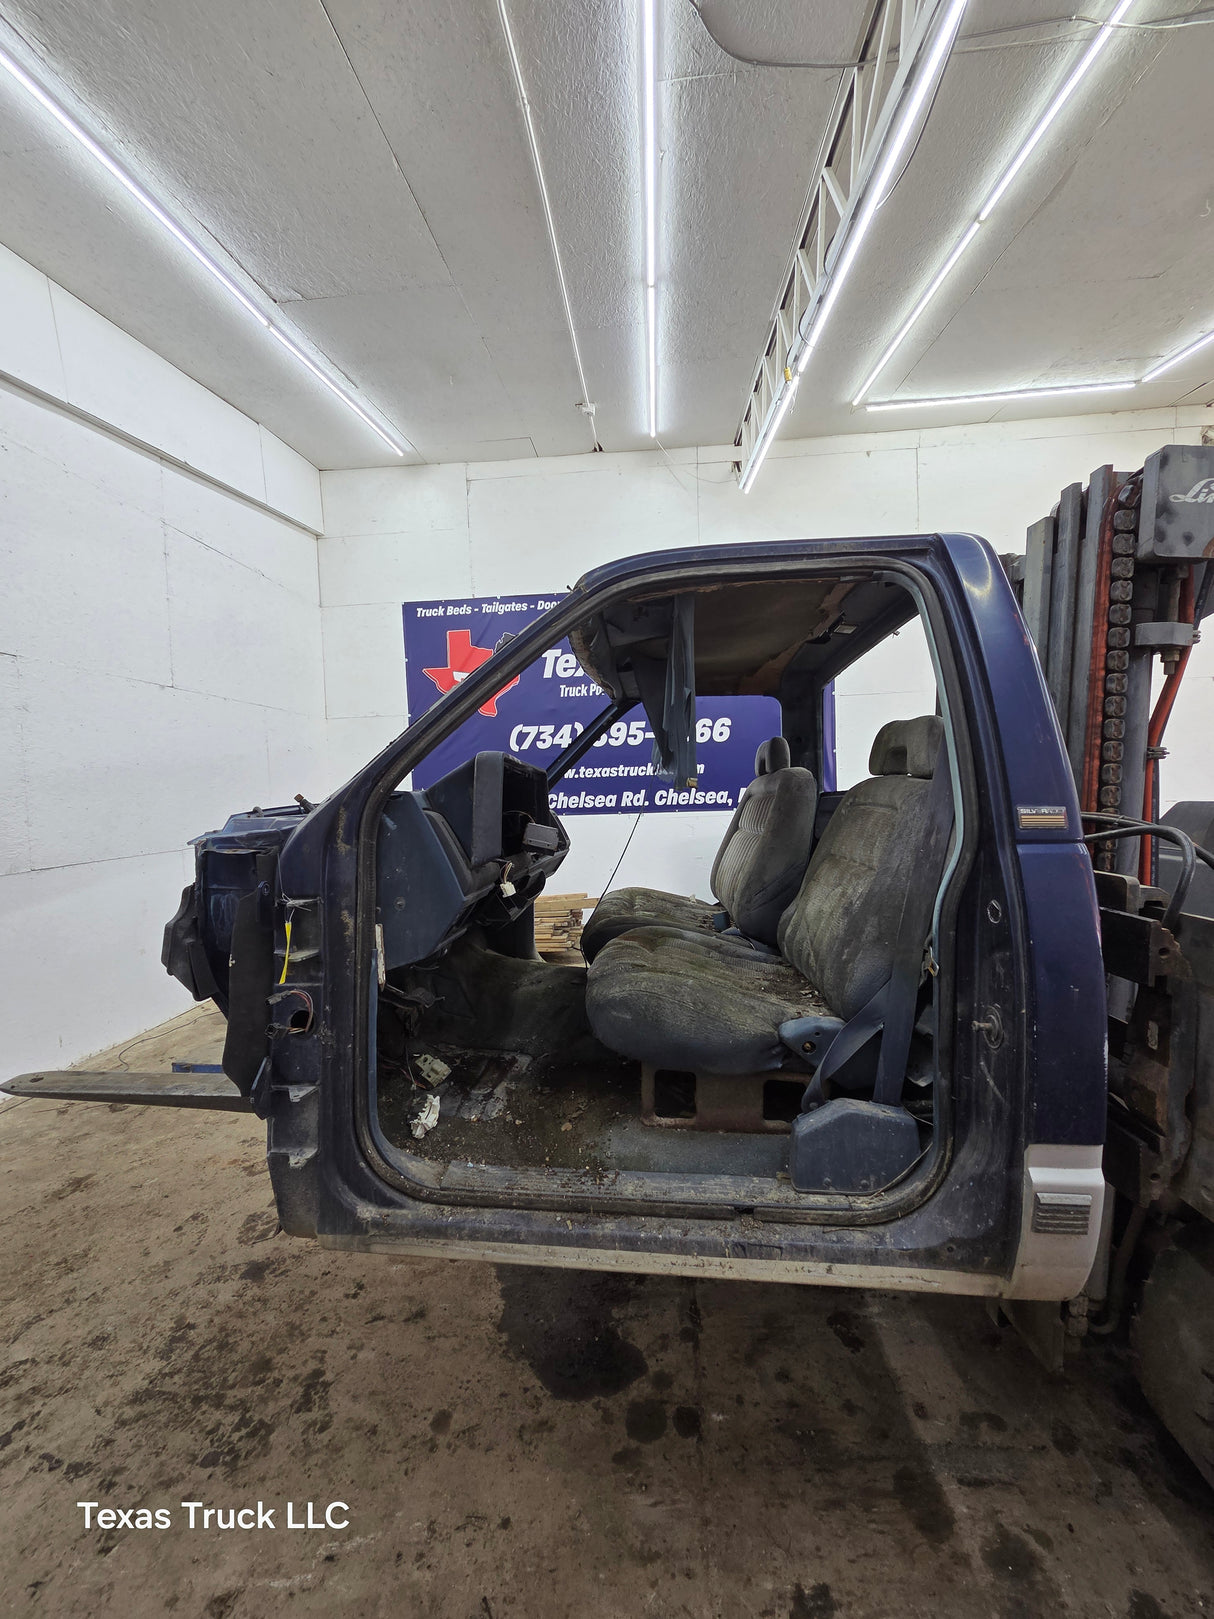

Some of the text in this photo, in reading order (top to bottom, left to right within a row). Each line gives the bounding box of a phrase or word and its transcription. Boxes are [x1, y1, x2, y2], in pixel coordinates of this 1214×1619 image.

[416, 606, 444, 618] Truck
[446, 604, 472, 616] Beds
[481, 601, 528, 615] Tailgates
[537, 600, 560, 610] Doo
[560, 684, 588, 697] Truck
[549, 791, 617, 809] Chelsea
[621, 789, 650, 807] Rd.
[654, 787, 733, 807] Chelsea,
